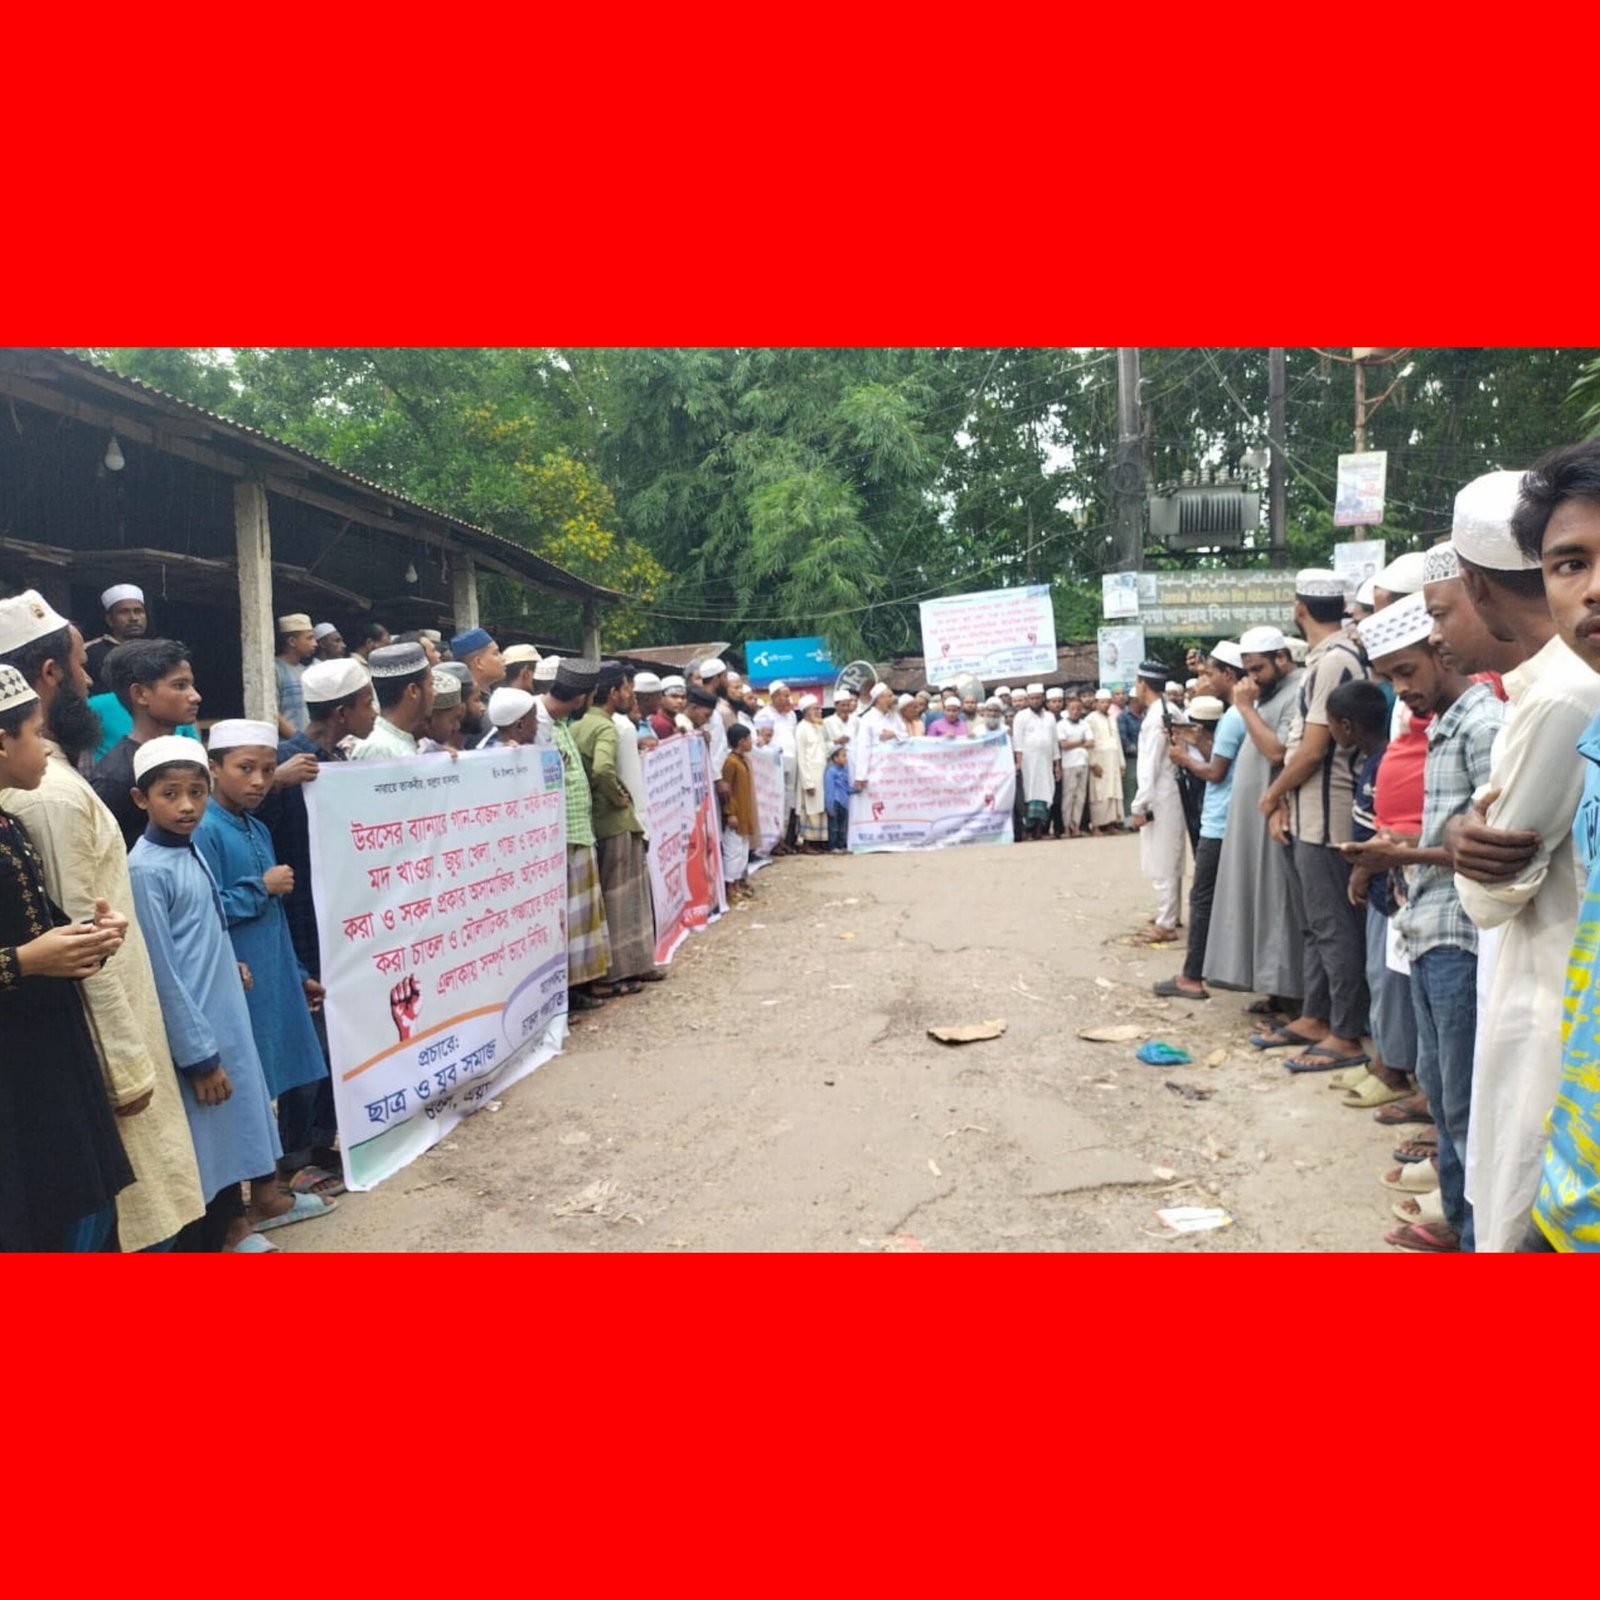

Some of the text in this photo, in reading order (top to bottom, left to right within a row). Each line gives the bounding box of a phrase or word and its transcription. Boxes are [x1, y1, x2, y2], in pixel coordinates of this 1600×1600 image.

[351, 820, 403, 852] উরসের
[367, 866, 391, 892] মদ
[342, 911, 375, 941] করা
[380, 909, 396, 931] ও
[398, 897, 435, 926] সকল
[438, 887, 466, 915] প্রকার
[372, 947, 407, 976] করা
[449, 930, 458, 950] ও
[418, 1034, 460, 1066] প্রচারে:
[364, 1088, 407, 1123] ছাত্র
[413, 1079, 431, 1100] ও
[434, 1063, 458, 1096] যুব
[461, 1038, 497, 1073] সমাজ
